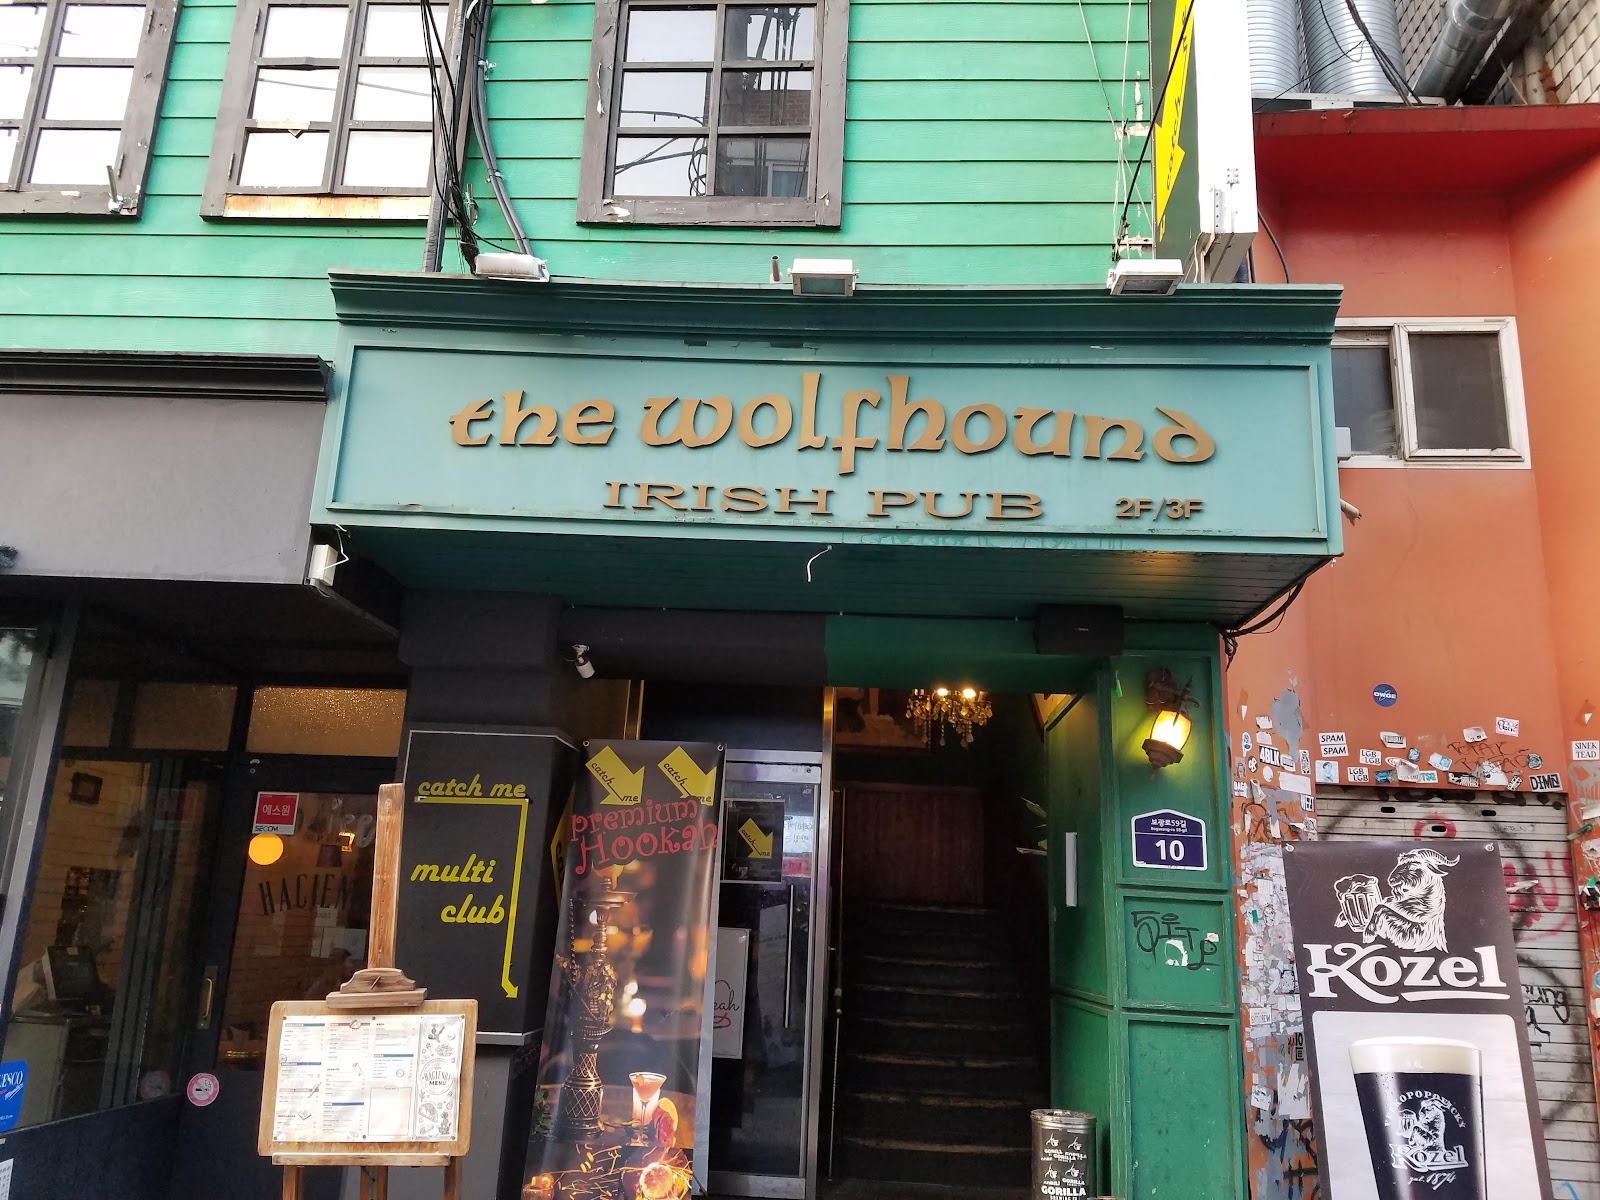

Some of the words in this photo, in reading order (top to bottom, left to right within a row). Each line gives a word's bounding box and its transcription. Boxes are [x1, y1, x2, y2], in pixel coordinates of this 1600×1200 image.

[449, 390, 616, 447] the
[640, 372, 1216, 476] wolfhound
[603, 481, 833, 515] IRISH
[867, 490, 1044, 520] PUB
[1115, 496, 1205, 521] 2F/3F
[1320, 734, 1345, 743] SPAM
[1323, 746, 1347, 755] SPAM
[1574, 742, 1598, 750] SINEK
[1575, 751, 1597, 759] TEAD
[418, 774, 482, 797] catch
[490, 782, 527, 797] me
[591, 762, 616, 786] catch
[663, 762, 688, 787] catch
[262, 804, 291, 816] 에스원
[571, 799, 699, 841] premium
[1151, 819, 1187, 828] 보광로59길
[1155, 840, 1185, 861] 10
[411, 854, 497, 883] multi
[258, 873, 350, 916] HACIEN
[440, 894, 505, 925] club
[1302, 942, 1508, 1004] Kozel
[0, 1071, 23, 1089] ESCO
[1388, 1143, 1469, 1173] Kozel
[1041, 1185, 1087, 1196] GORILLA
